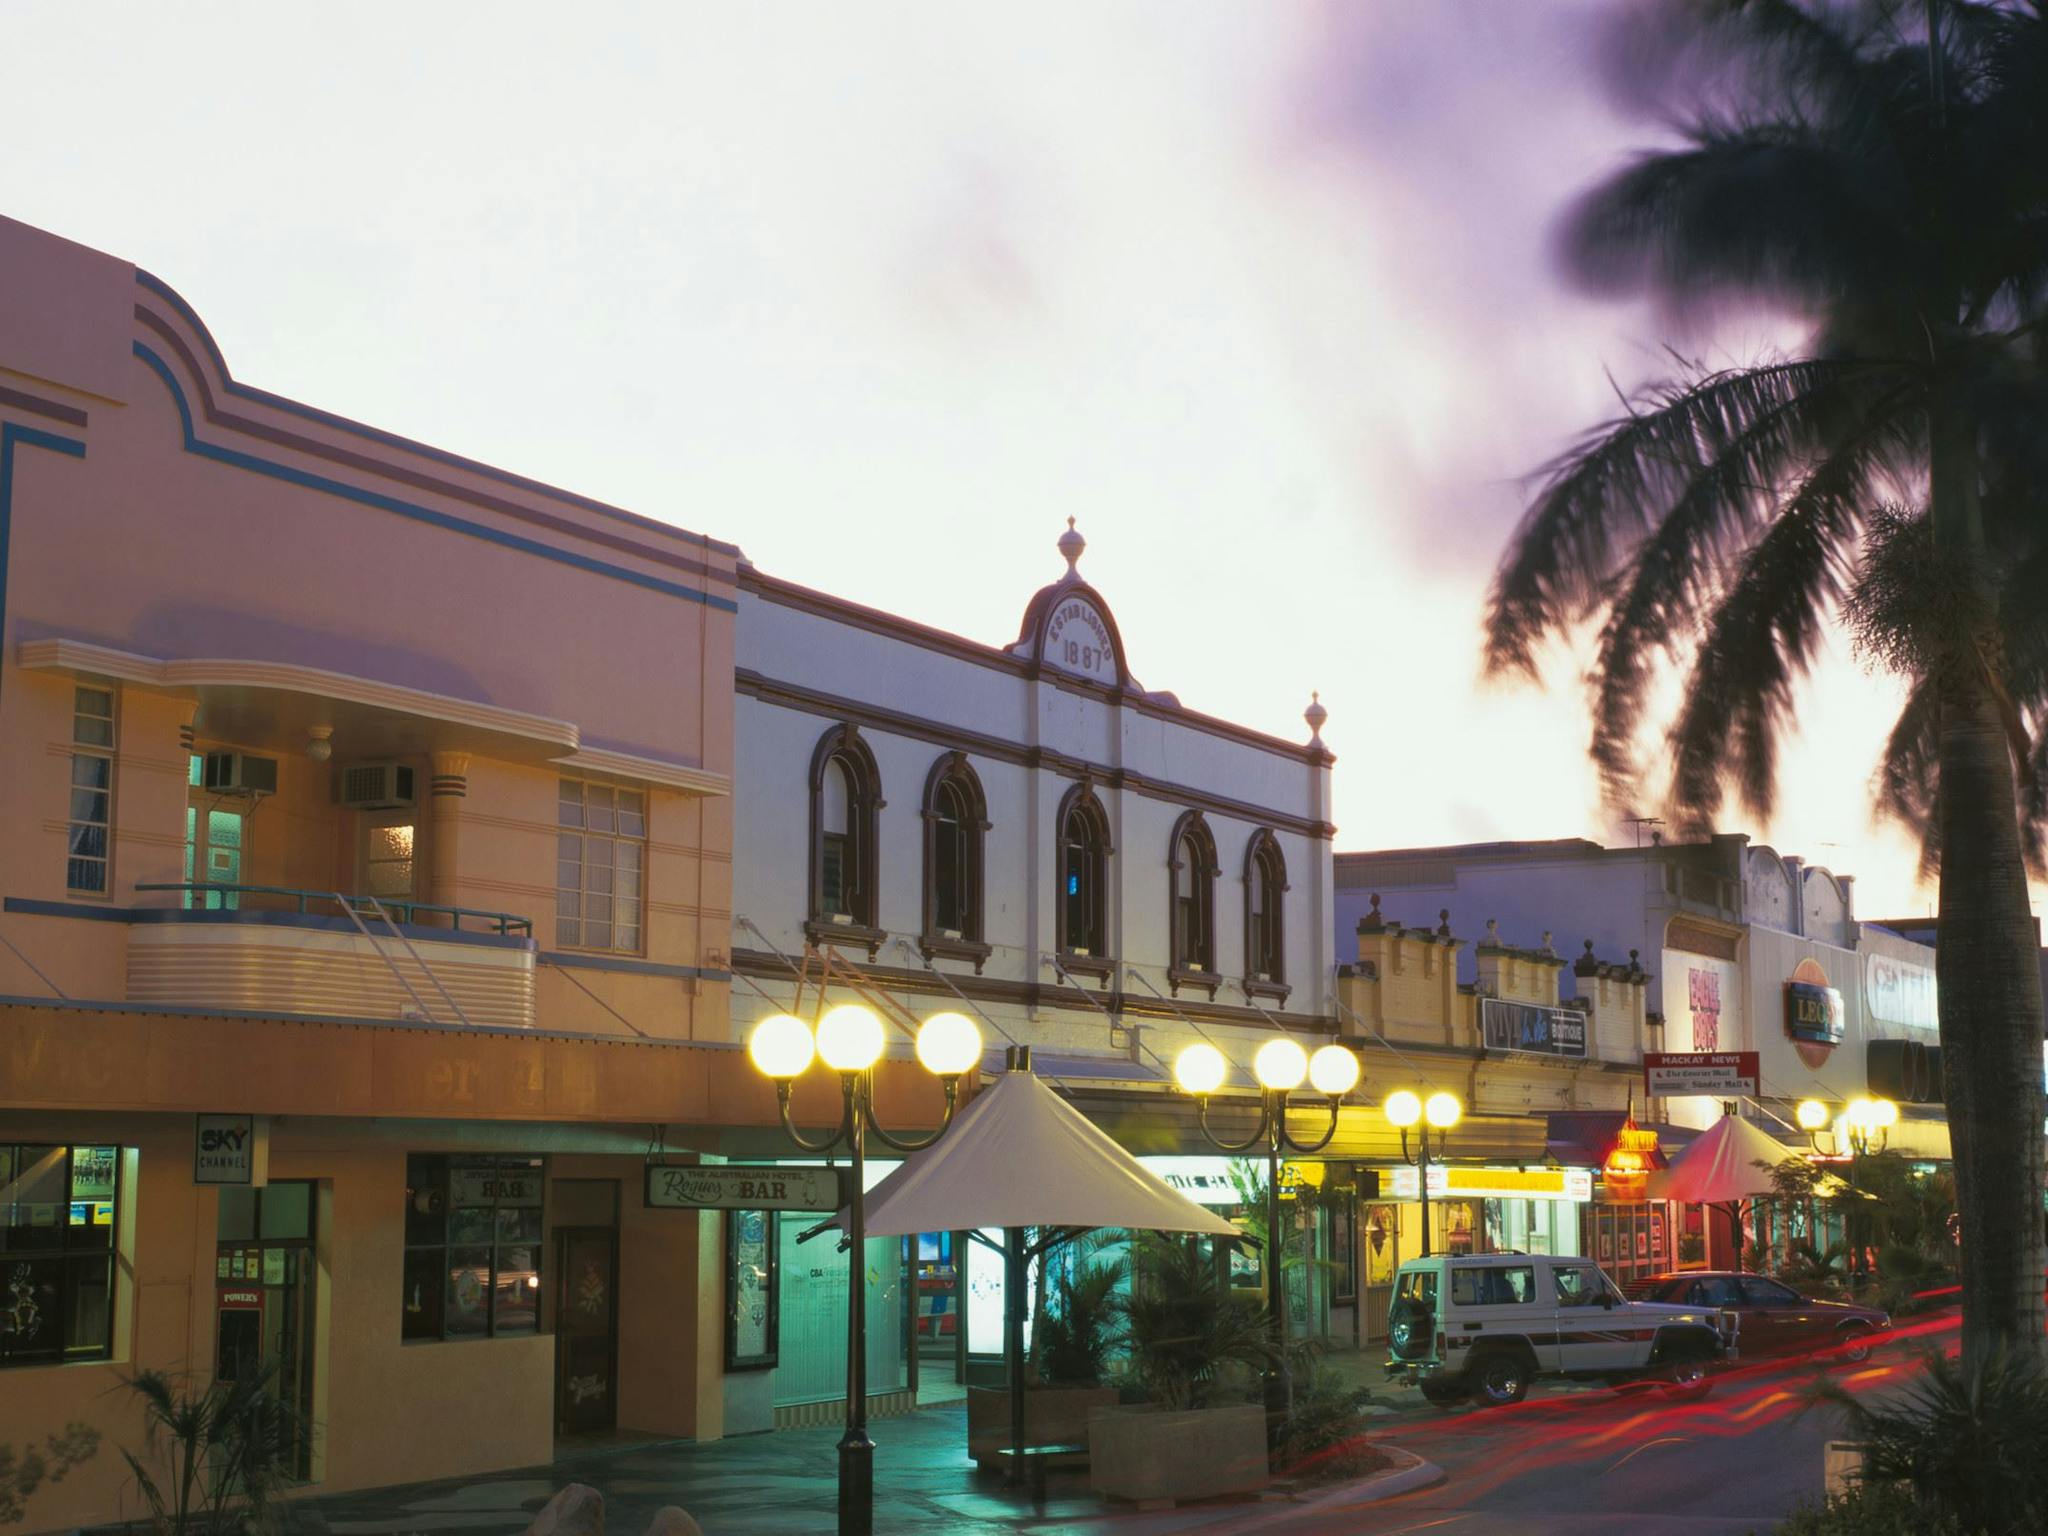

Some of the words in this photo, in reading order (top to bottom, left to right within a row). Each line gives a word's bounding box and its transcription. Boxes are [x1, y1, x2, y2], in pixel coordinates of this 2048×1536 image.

[1049, 603, 1113, 662] ESTABLISHED
[1064, 639, 1102, 672] 1887
[1551, 1023, 1582, 1041] BOUTIQUE
[1661, 1056, 1705, 1065] MACKAY
[1711, 1055, 1741, 1064] NEWS
[201, 1128, 248, 1152] SKY
[200, 1156, 246, 1169] CHANNEL
[688, 1170, 706, 1179] THE
[708, 1171, 770, 1180] AUSTRALIAN
[773, 1172, 804, 1181] HOTEL
[663, 1170, 722, 1203] Rogues
[739, 1181, 788, 1200] BAR
